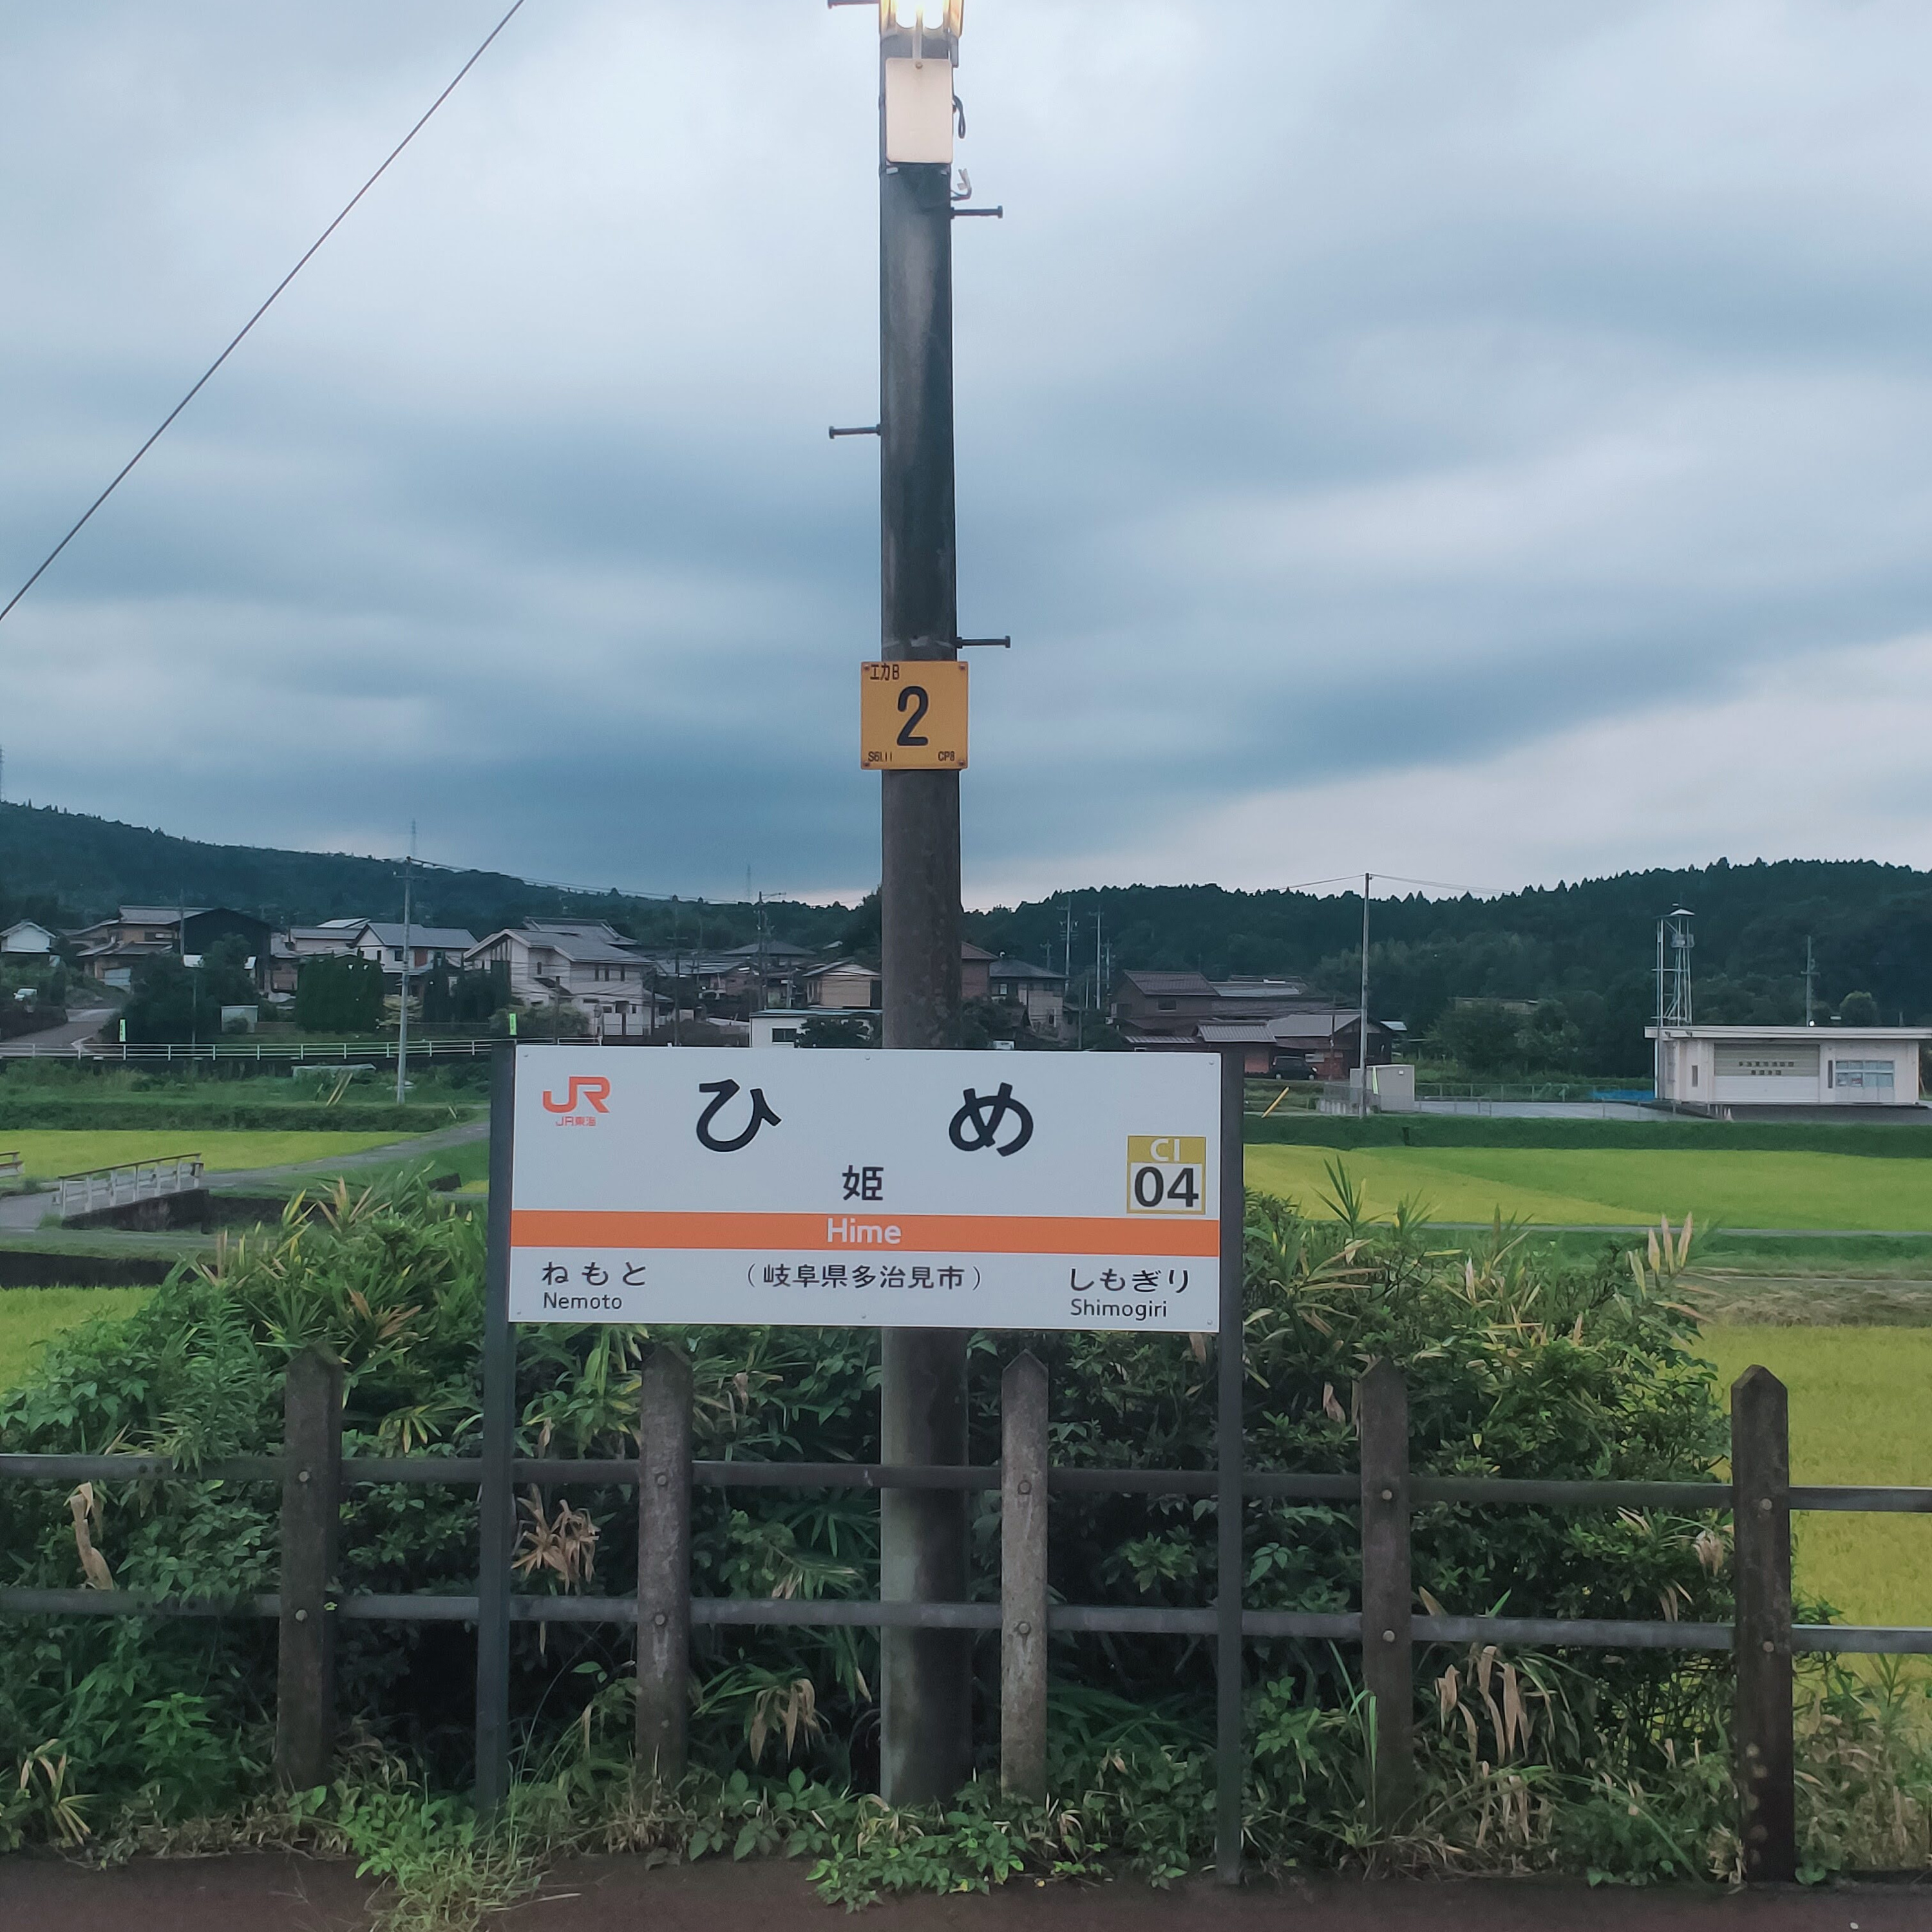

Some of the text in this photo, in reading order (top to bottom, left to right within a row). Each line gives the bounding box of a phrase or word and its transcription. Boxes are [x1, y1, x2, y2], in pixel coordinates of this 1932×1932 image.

[896, 685, 929, 747] 2
[938, 750, 955, 762] CP8
[543, 1076, 611, 1113] JR
[555, 1116, 596, 1126] JR東海
[1150, 1138, 1181, 1162] CI
[842, 1164, 884, 1201] 姫
[1133, 1166, 1200, 1208] 04
[826, 1217, 904, 1244] Hime
[541, 1262, 646, 1286] ねもと
[1070, 1267, 1189, 1294] しもぎり
[543, 1292, 623, 1310] Nemoto
[1070, 1298, 1167, 1321] Shimogiri
